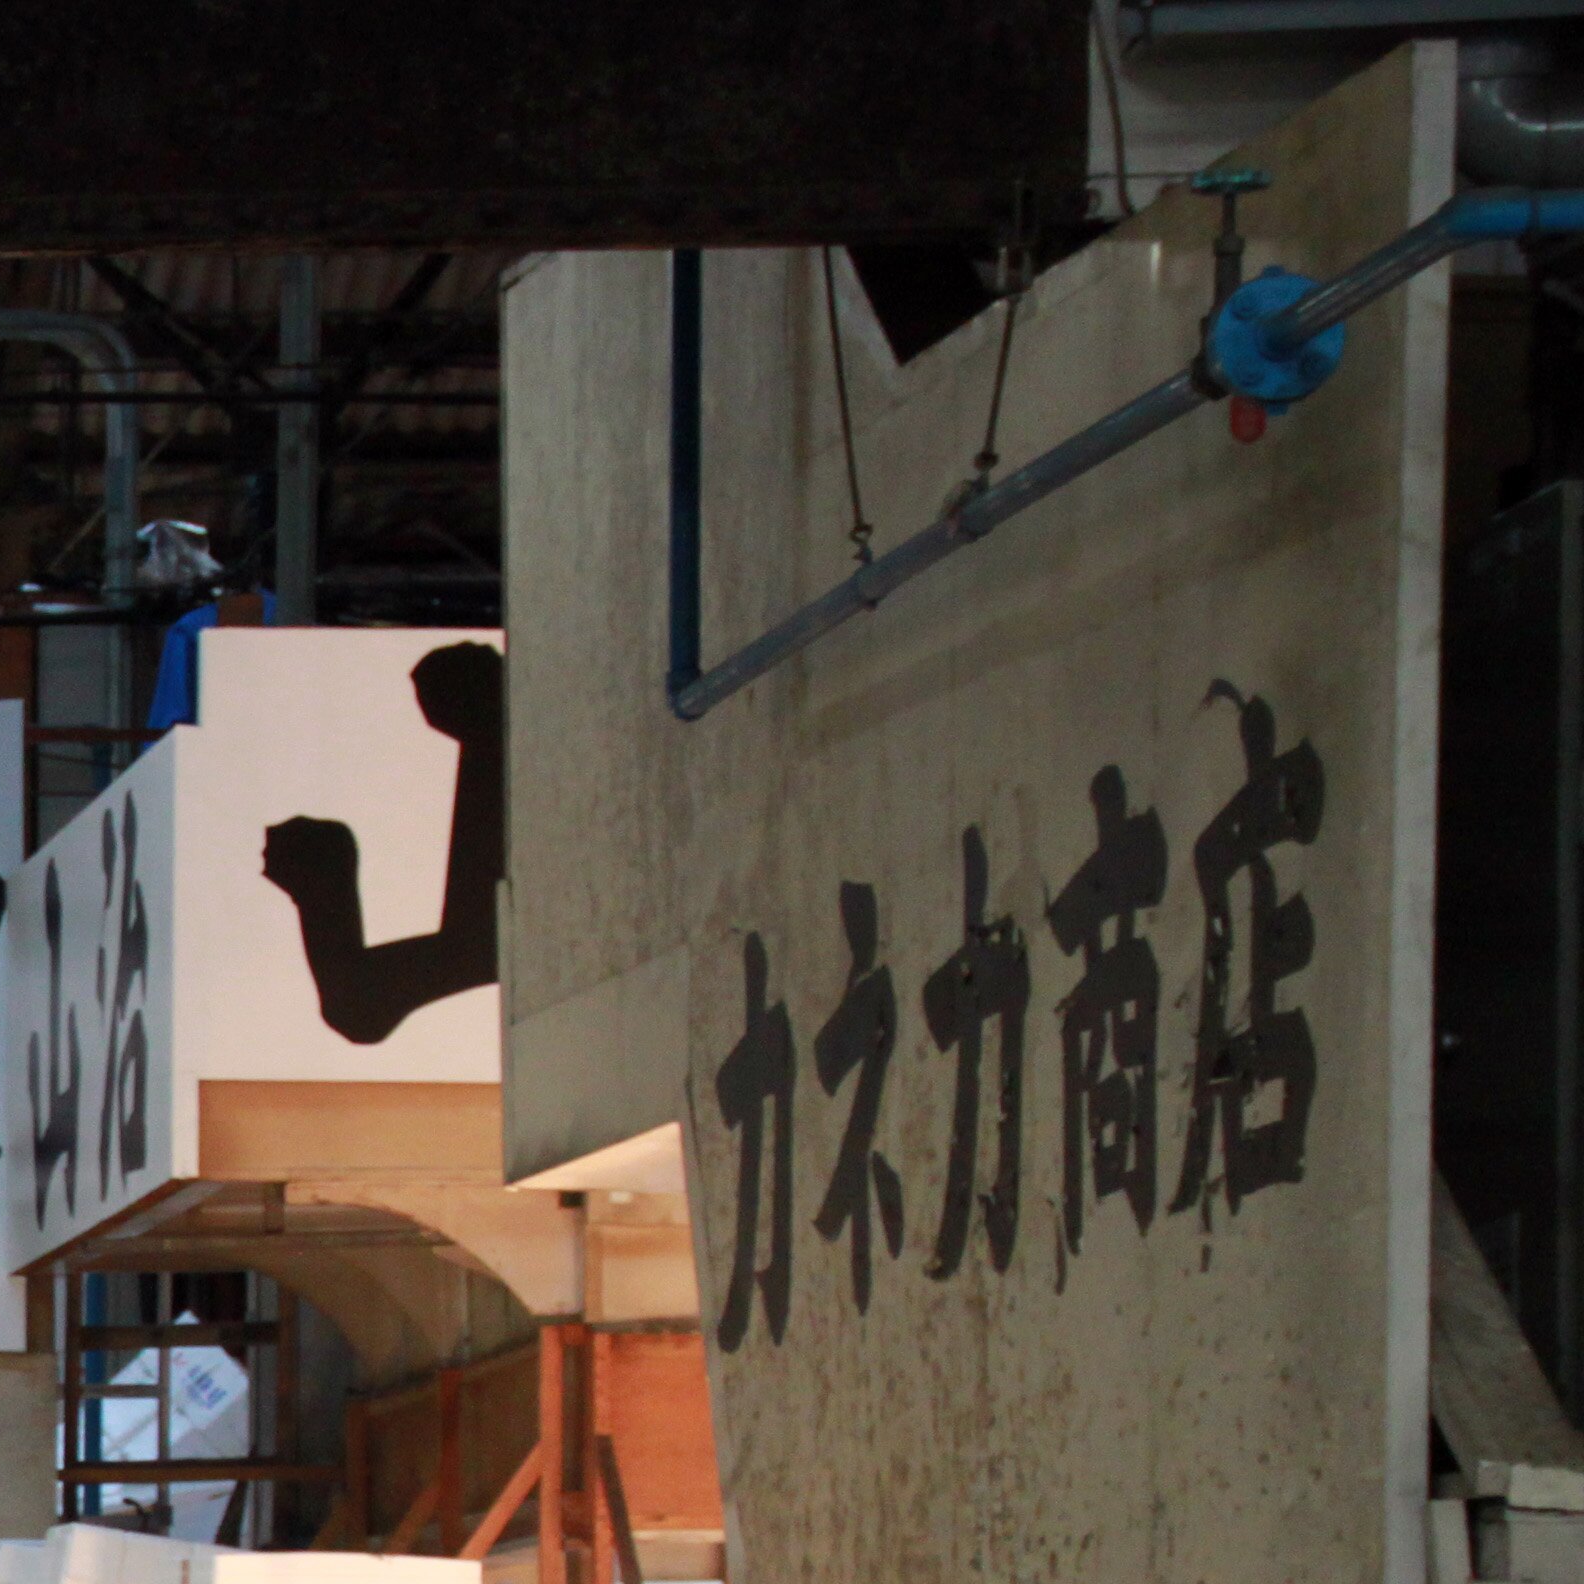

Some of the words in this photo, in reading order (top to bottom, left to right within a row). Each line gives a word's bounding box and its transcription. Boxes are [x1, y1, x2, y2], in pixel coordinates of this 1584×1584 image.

[30, 789, 150, 1232] 山治
[716, 677, 1327, 1354] カネカ商店
